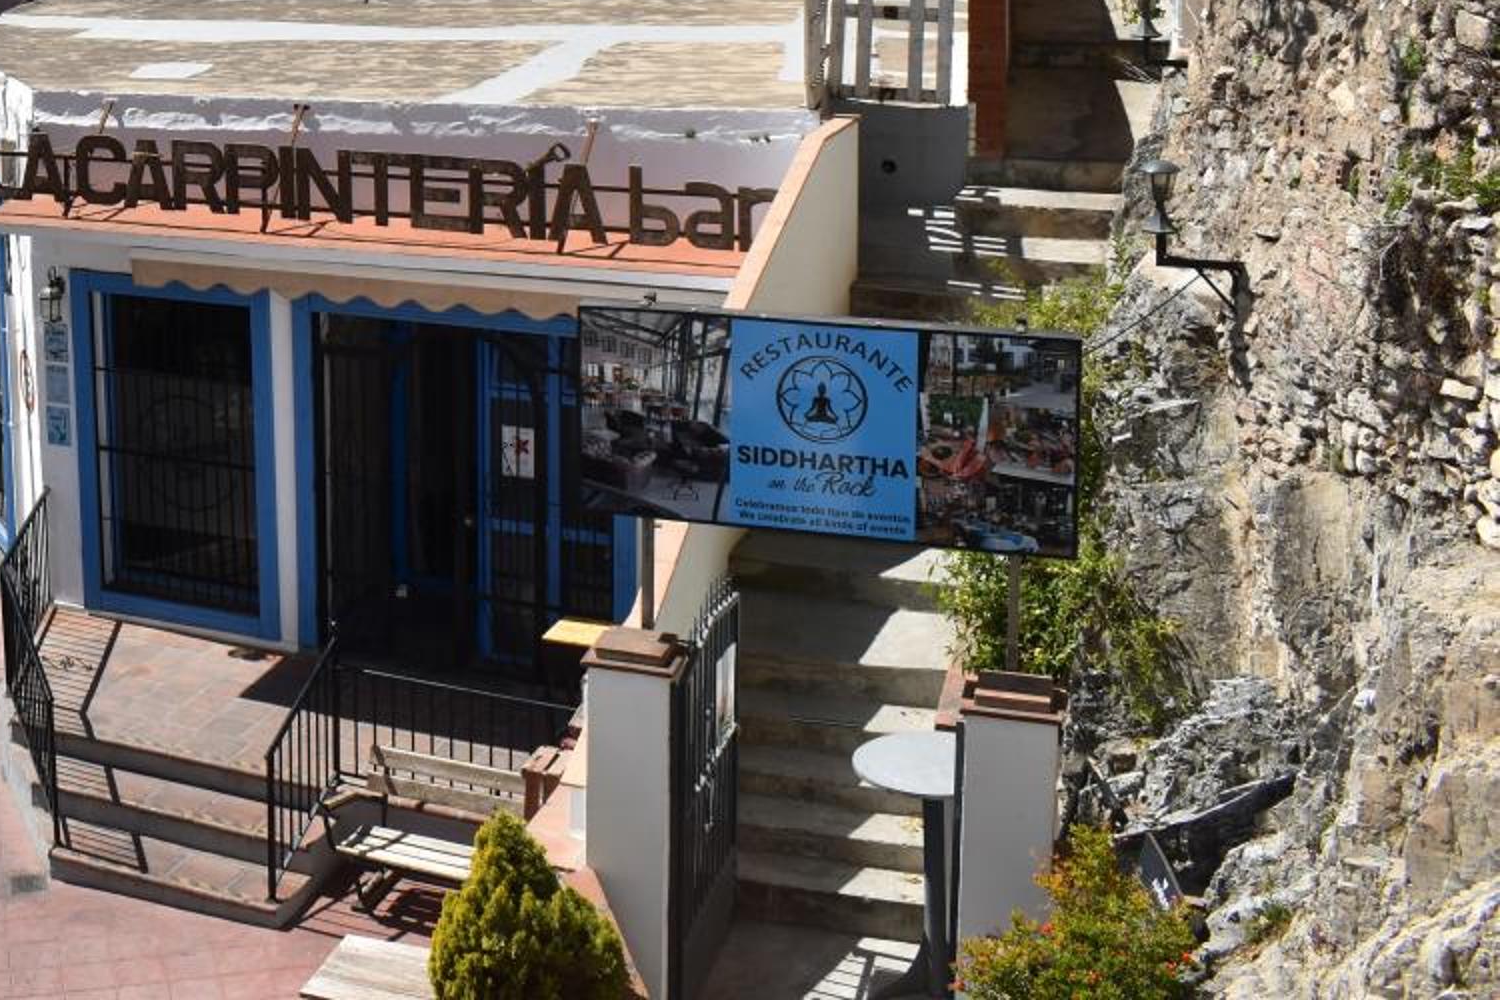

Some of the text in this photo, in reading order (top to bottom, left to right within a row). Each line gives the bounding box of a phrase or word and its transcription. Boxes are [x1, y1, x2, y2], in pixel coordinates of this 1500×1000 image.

[629, 165, 778, 252] bar
[740, 331, 914, 393] RESTAURANTE
[737, 445, 909, 480] SIDDHARTHA
[793, 472, 816, 494] the
[814, 471, 877, 497] Rock
